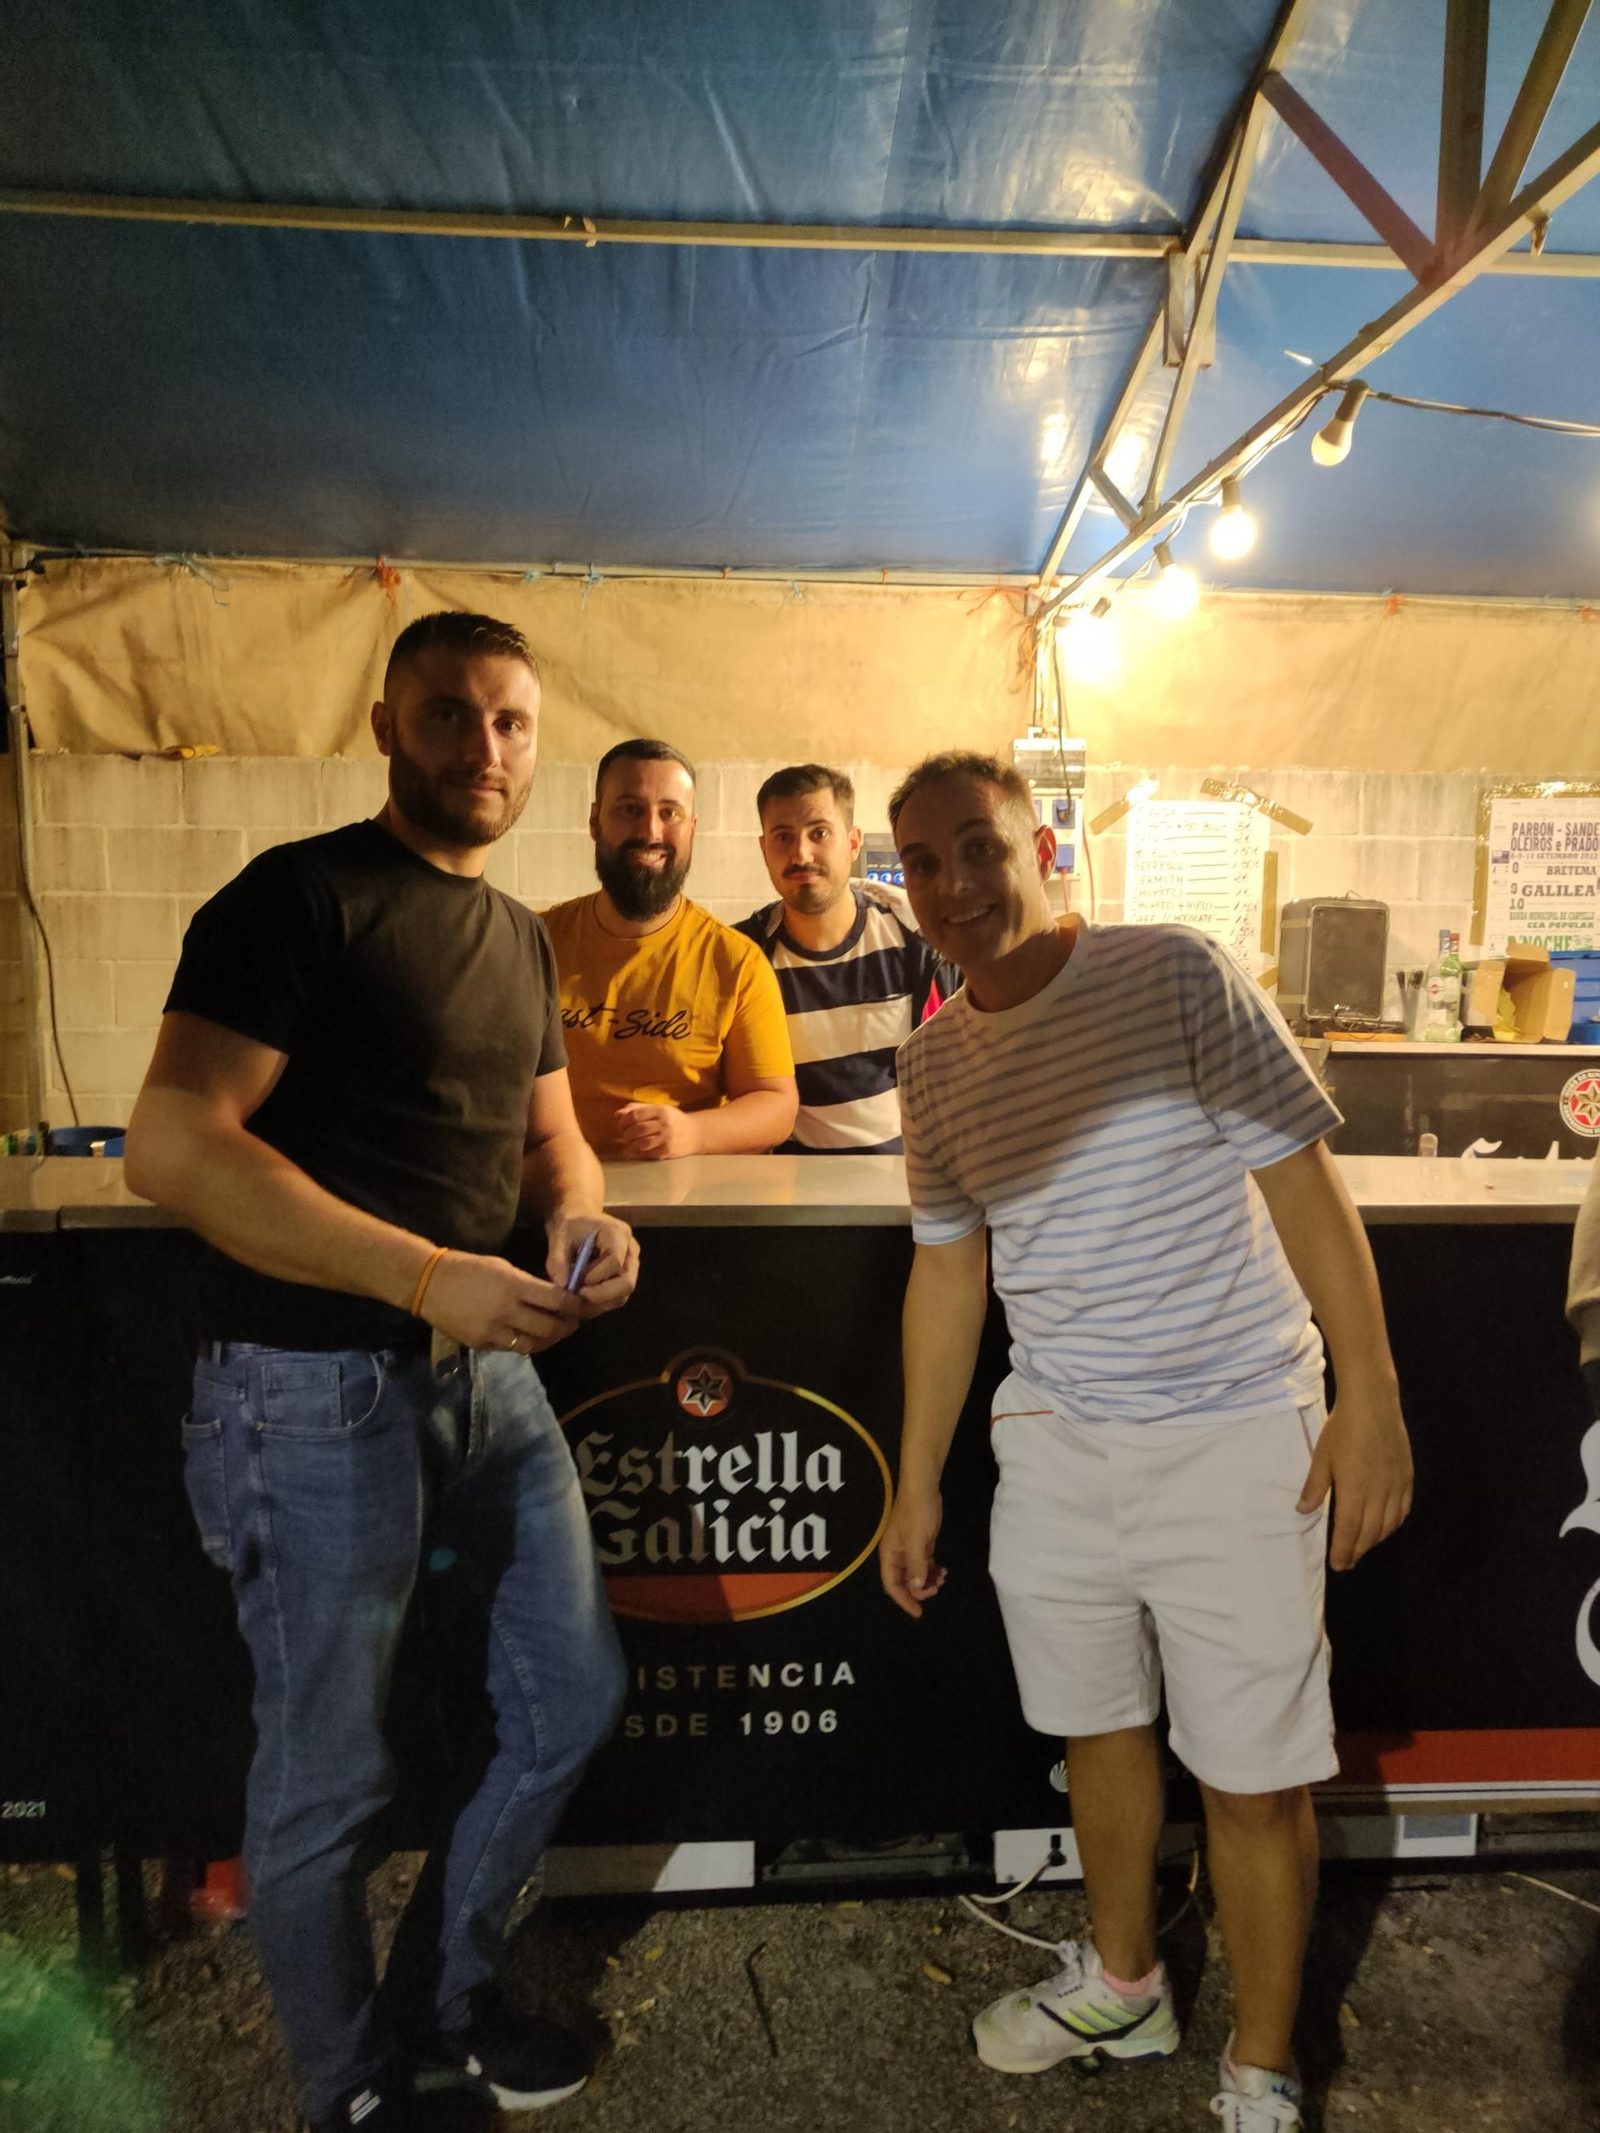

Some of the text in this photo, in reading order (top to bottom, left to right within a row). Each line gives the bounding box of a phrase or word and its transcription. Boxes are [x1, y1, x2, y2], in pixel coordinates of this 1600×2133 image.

[1565, 822, 1600, 837] SANDE
[1510, 837, 1599, 851] OLEIROS e PRADO
[1546, 866, 1597, 876] BRETEMA
[1521, 885, 1596, 897] GALILEA
[1509, 898, 1525, 910] 10
[576, 1431, 846, 1496] Estrella
[588, 1498, 832, 1566] Galicia
[739, 1709, 838, 1736] 1906
[1, 1800, 46, 1819] 2021
